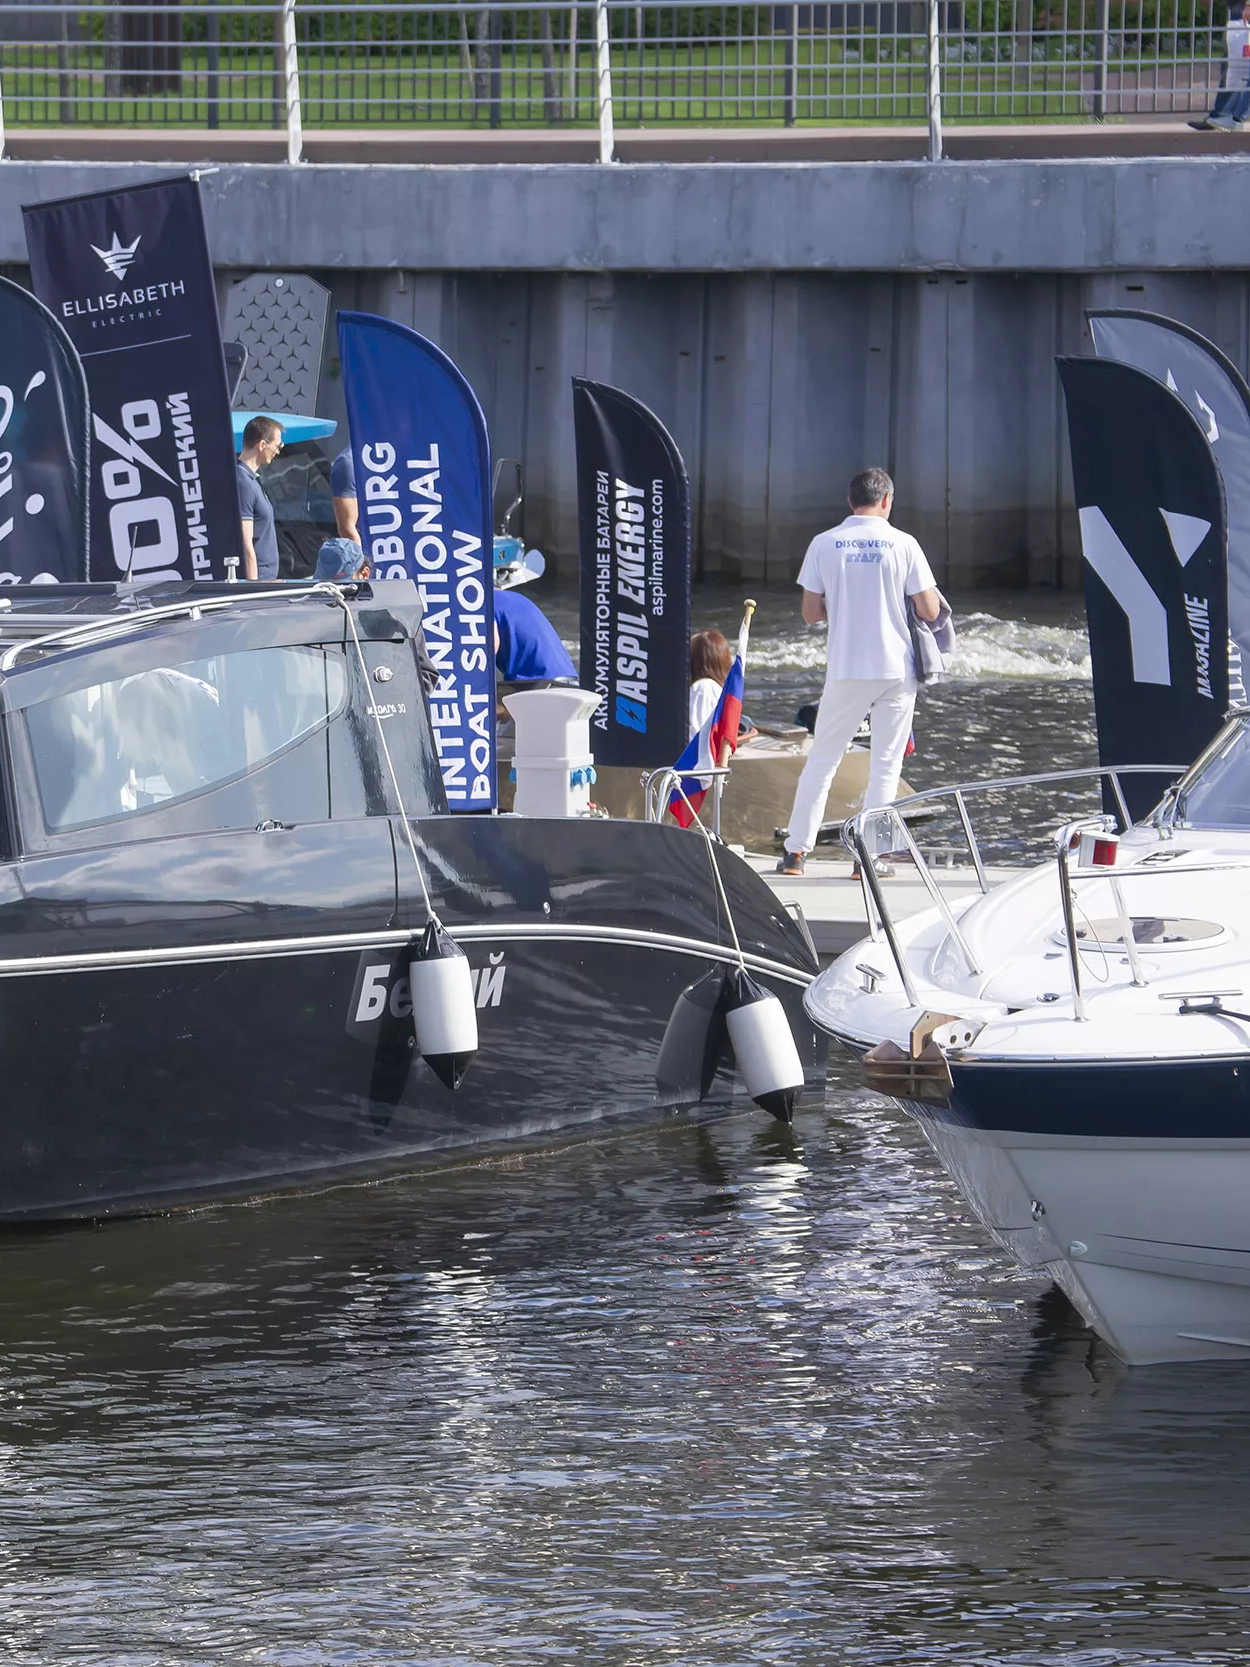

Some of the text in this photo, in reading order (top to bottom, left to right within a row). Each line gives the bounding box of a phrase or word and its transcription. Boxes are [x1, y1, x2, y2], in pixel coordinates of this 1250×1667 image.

[62, 280, 185, 317] ELLISABETH
[91, 308, 162, 328] ELECTRIC
[93, 399, 183, 580] 0%
[596, 470, 610, 548] БАТАРЕИ
[615, 478, 649, 704] ASPIL ENERGY
[648, 479, 666, 616] aspilmarine.com
[835, 539, 894, 549] DISCOVERY
[407, 443, 467, 800] INTERNATIONAL
[452, 530, 491, 799] BOAT SHOW
[355, 951, 507, 1022] Бей
